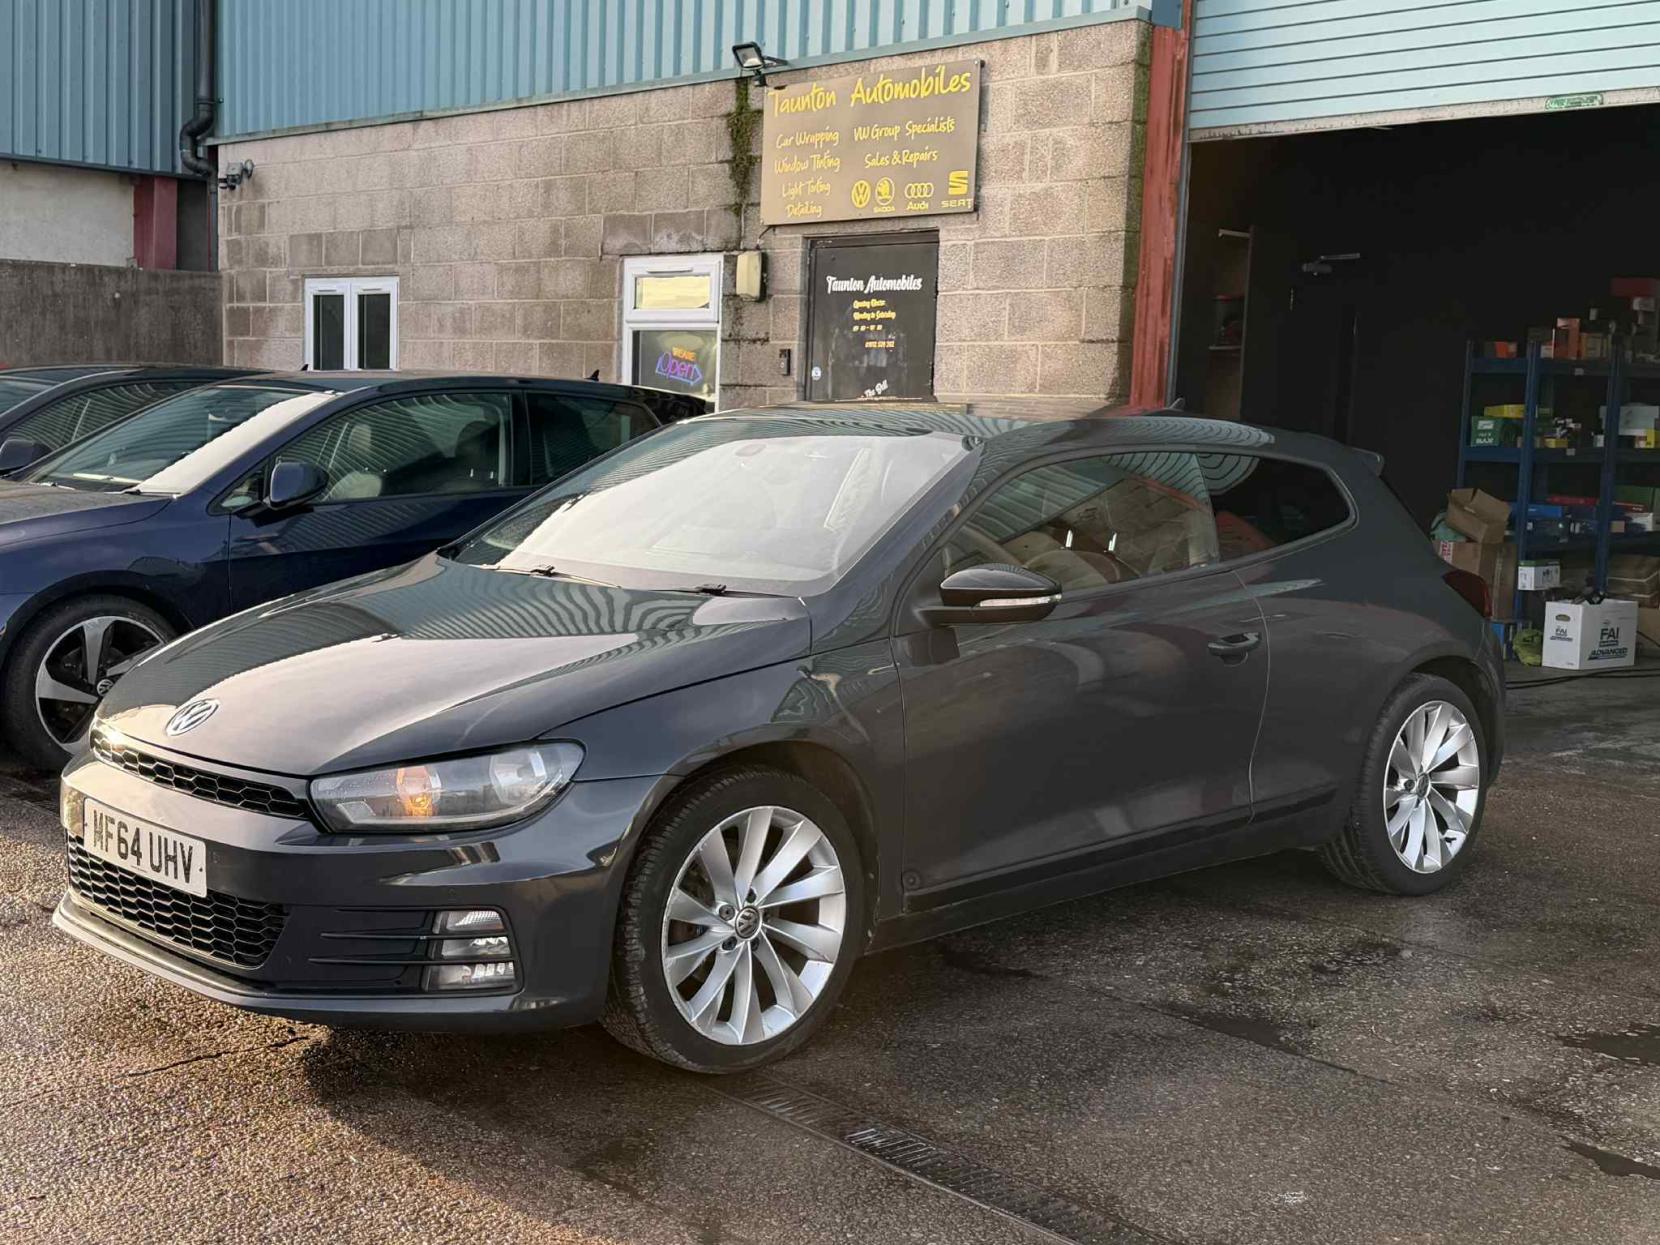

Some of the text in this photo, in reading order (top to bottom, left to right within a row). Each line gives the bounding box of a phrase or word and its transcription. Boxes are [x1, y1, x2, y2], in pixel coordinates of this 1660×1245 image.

[768, 65, 972, 117] Taunton Automobiles
[776, 125, 839, 149] Car Wrapping
[870, 124, 900, 141] Group
[905, 116, 955, 140] Specialists
[774, 150, 840, 174] Window Tinting
[864, 146, 938, 169] Sales & Repairs
[906, 200, 929, 211] Audi
[826, 274, 923, 294] Taunton Automobiles
[663, 351, 696, 380] Open
[1600, 627, 1620, 640] FAI
[149, 831, 194, 884] UHV
